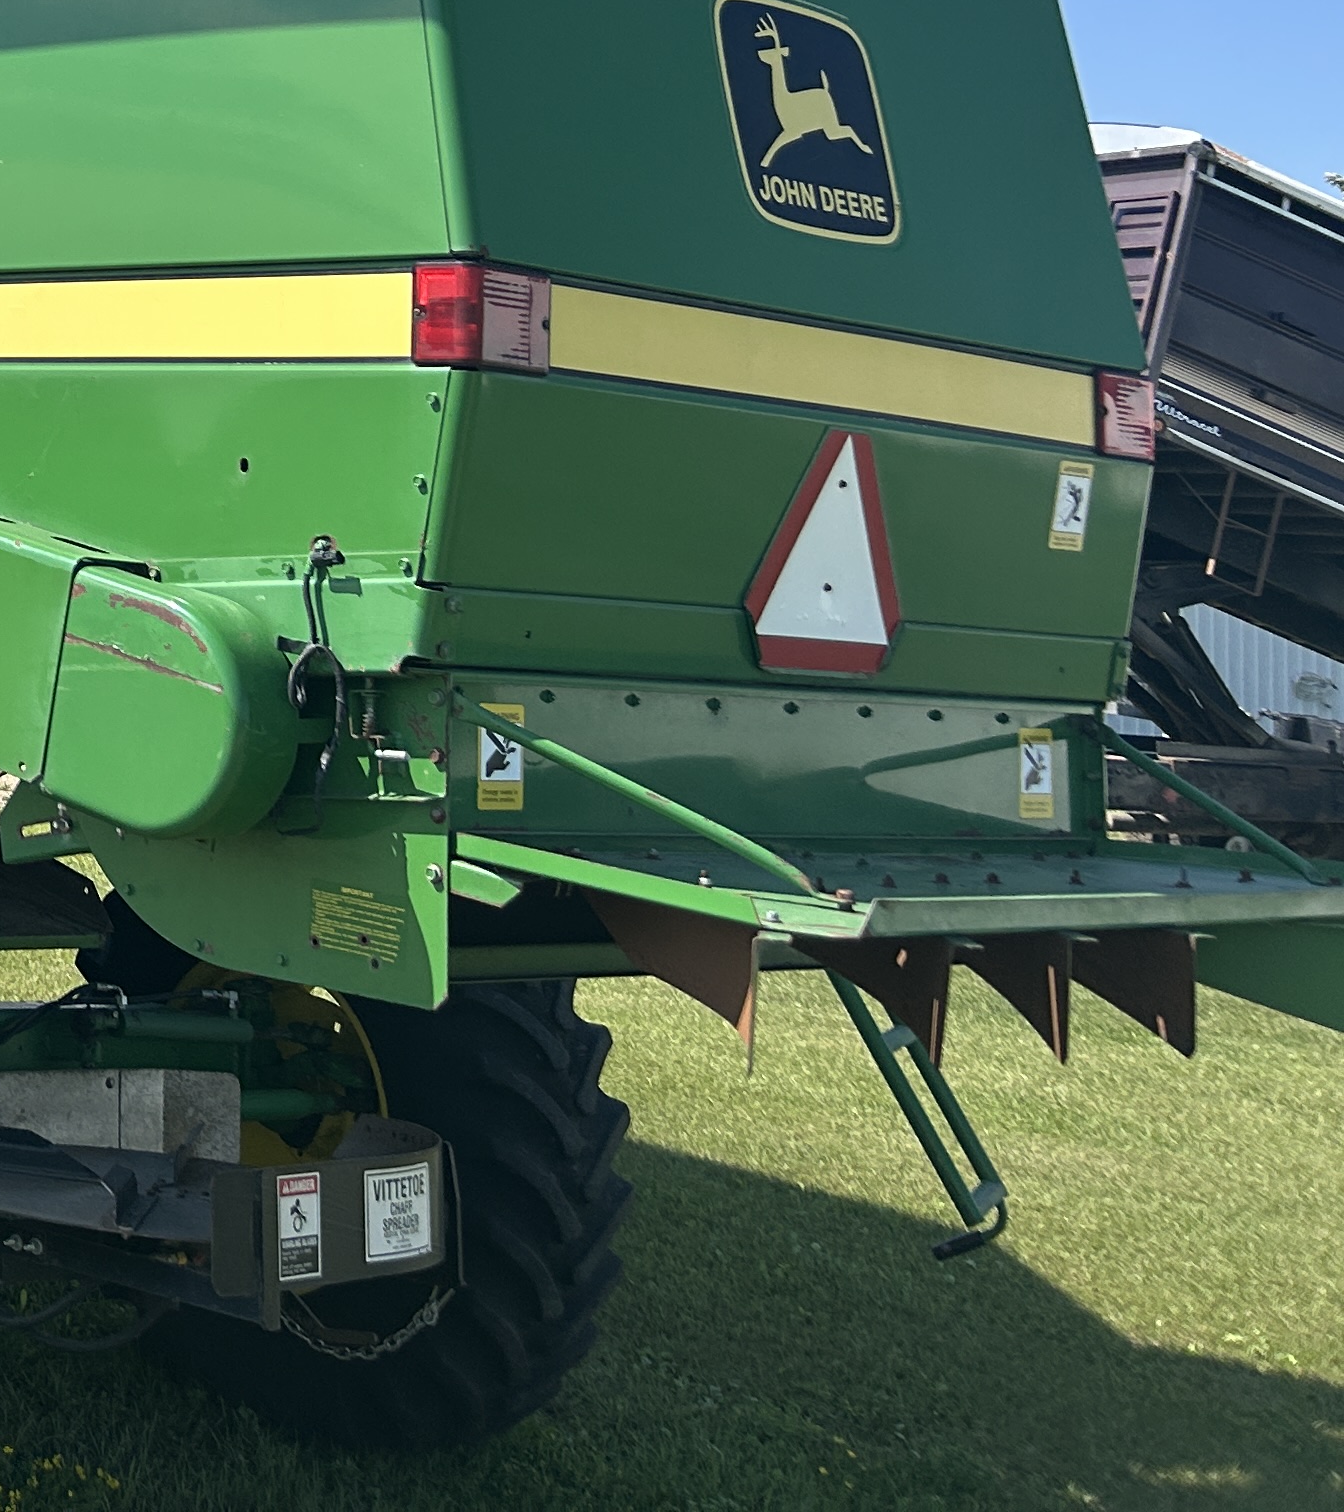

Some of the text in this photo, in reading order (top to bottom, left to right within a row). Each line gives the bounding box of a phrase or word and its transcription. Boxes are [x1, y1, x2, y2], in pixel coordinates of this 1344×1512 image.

[759, 174, 888, 223] JOHN DEERE
[289, 1178, 316, 1193] DANGER
[372, 1173, 425, 1203] VITTETOE
[390, 1199, 413, 1216] CHAFF
[382, 1213, 420, 1233] SPREADER
